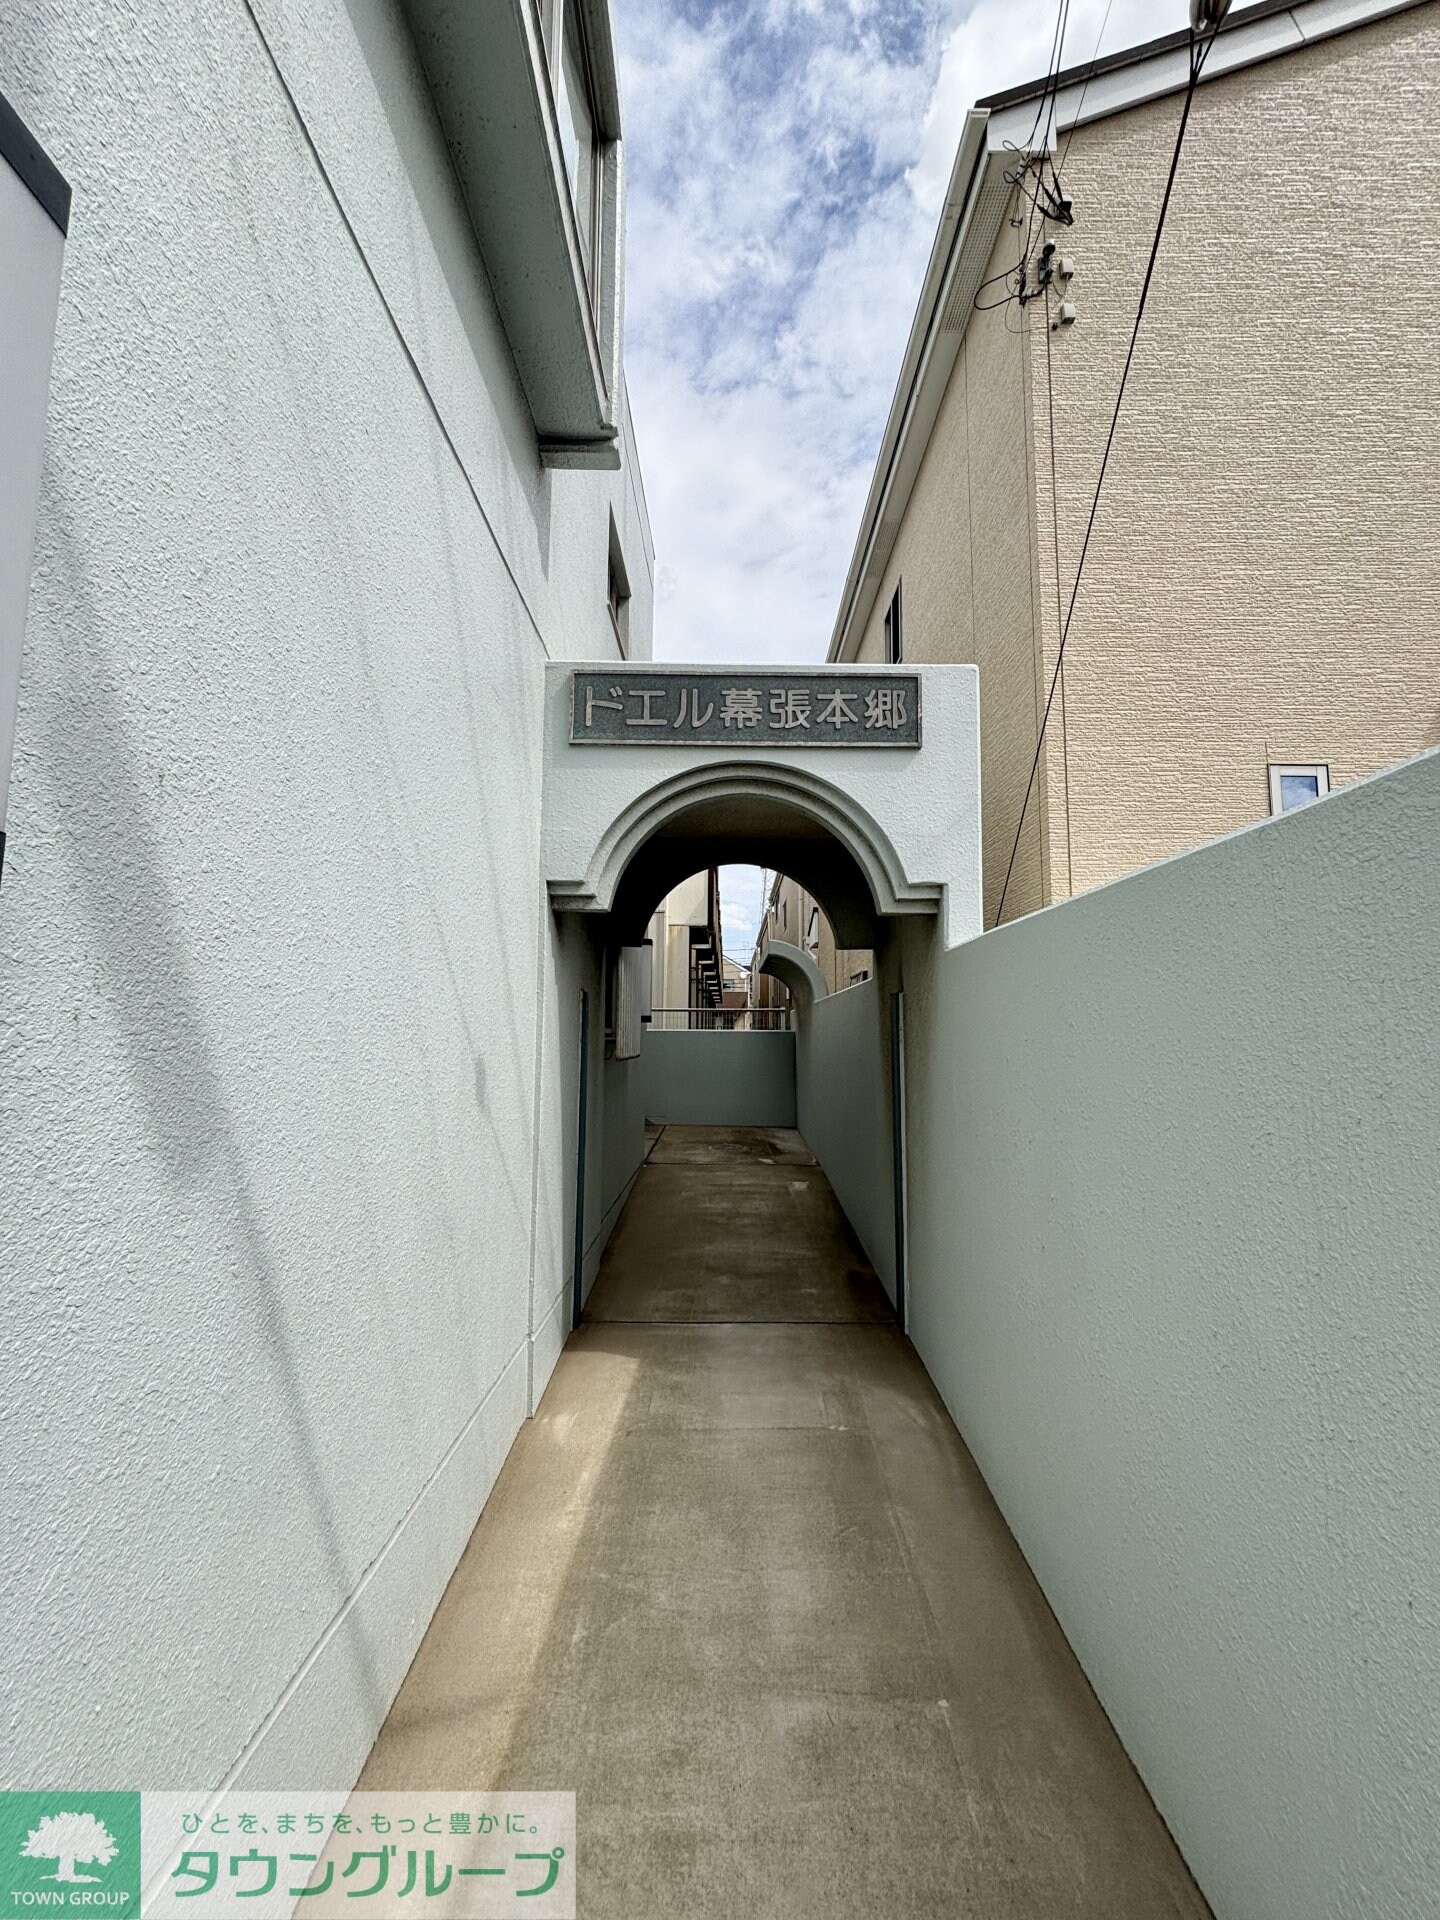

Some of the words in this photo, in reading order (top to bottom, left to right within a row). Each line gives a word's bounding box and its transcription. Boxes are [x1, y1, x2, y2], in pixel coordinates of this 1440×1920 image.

[584, 685, 907, 730] ドエル幕張本郷
